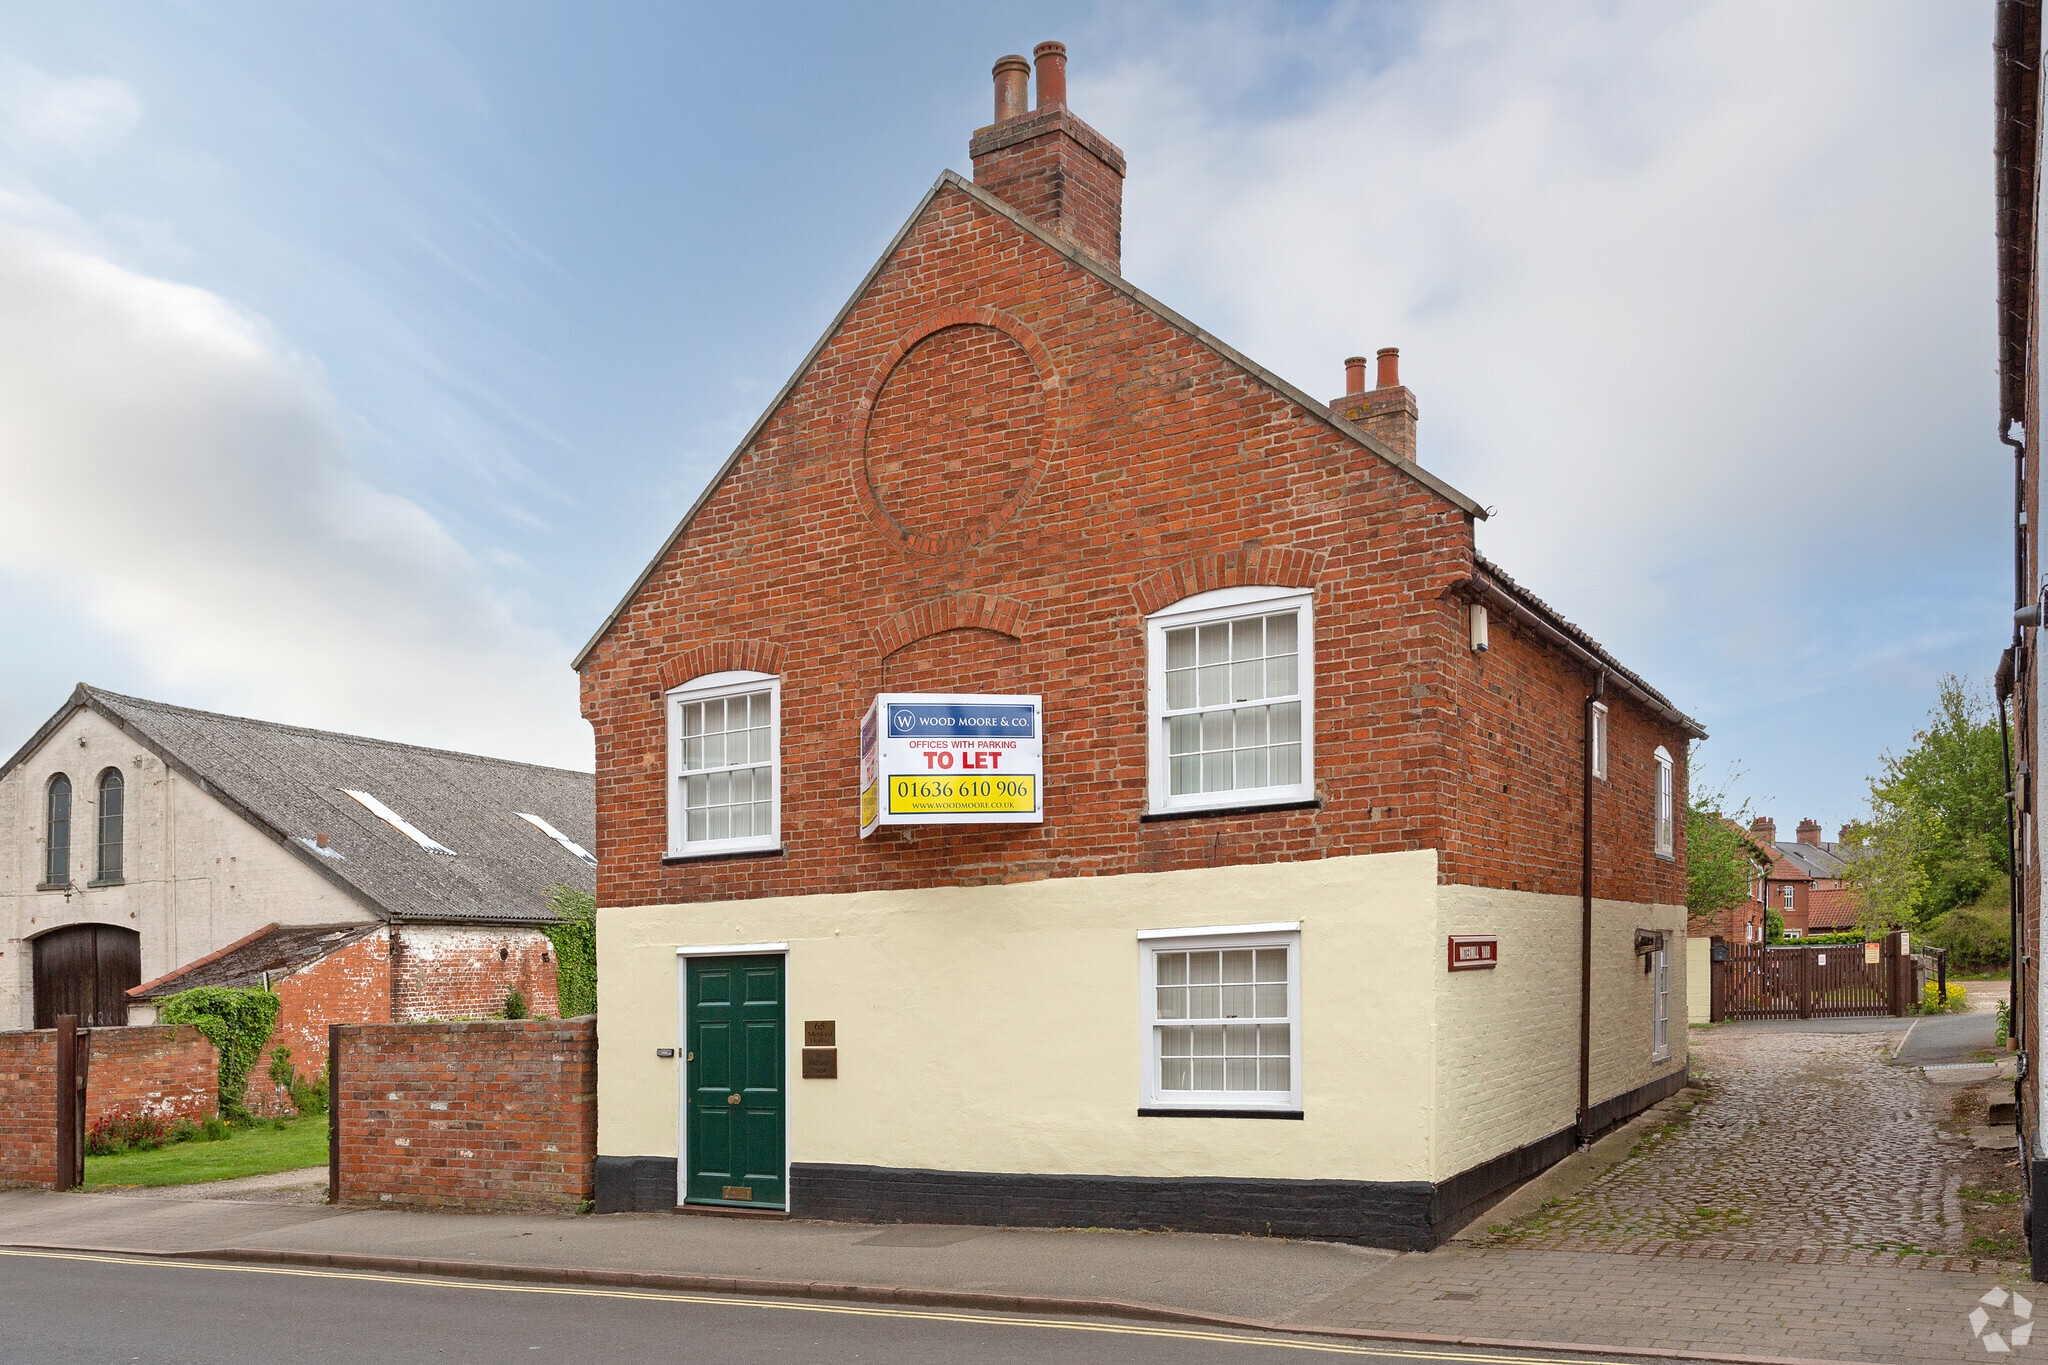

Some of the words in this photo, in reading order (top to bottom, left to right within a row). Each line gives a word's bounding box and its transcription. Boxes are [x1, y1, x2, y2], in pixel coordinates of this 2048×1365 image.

[919, 717, 956, 727] WOOD
[958, 717, 997, 727] MOORE
[1000, 717, 1009, 727] &
[1011, 717, 1030, 727] CO.
[909, 740, 949, 749] OFFICES
[950, 740, 975, 749] WITH
[977, 740, 1017, 749] PARKING
[923, 751, 954, 770] TO
[962, 751, 1003, 770] LET
[897, 781, 953, 798] 01636
[959, 781, 991, 797] 610
[996, 781, 1028, 797] 906
[814, 1022, 826, 1030] 65
